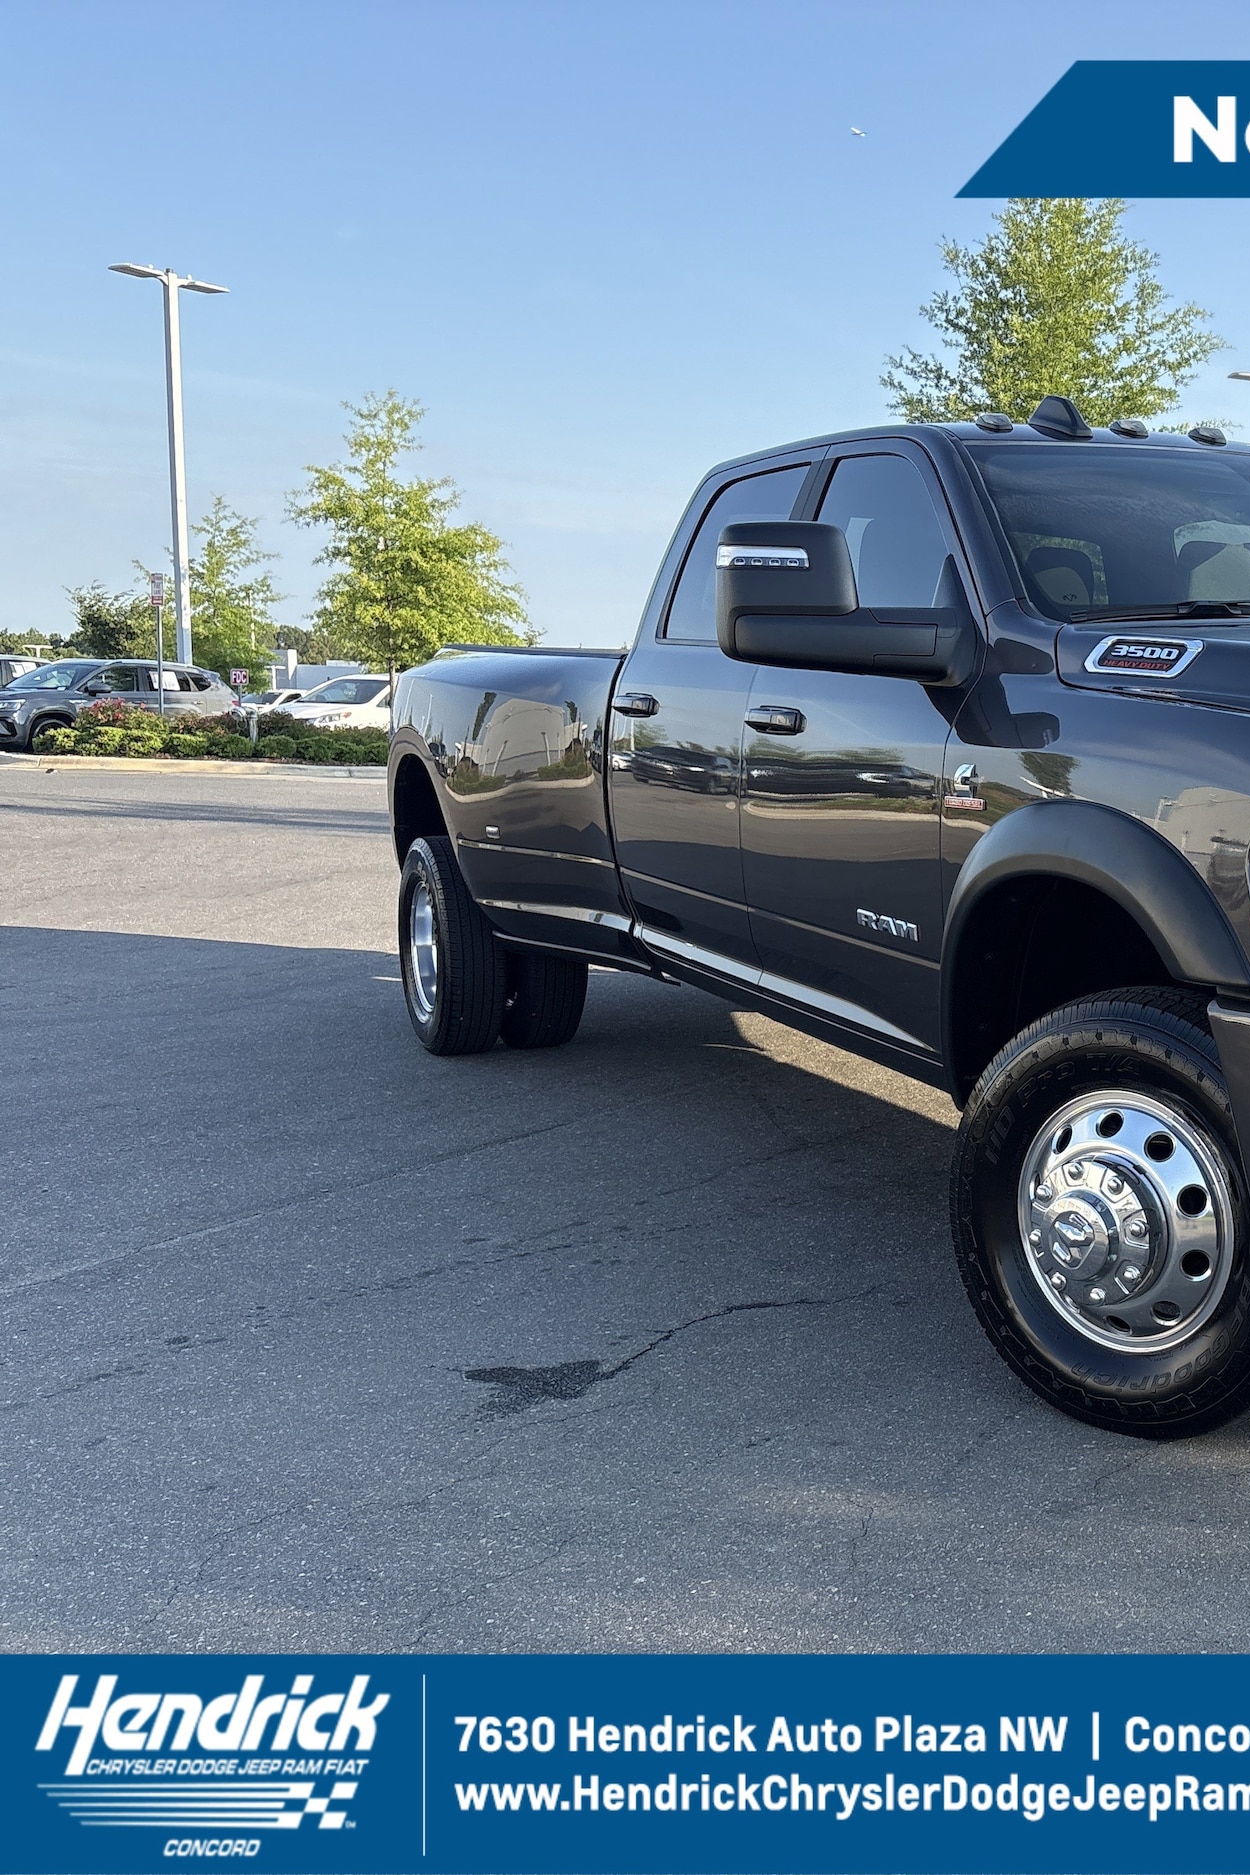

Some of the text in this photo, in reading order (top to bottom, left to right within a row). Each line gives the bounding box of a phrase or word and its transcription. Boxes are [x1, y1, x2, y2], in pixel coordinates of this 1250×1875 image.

[1111, 645, 1179, 660] 3500
[1103, 659, 1171, 670] HEAVY DUTY
[232, 671, 246, 683] FDC
[856, 908, 919, 942] RAM
